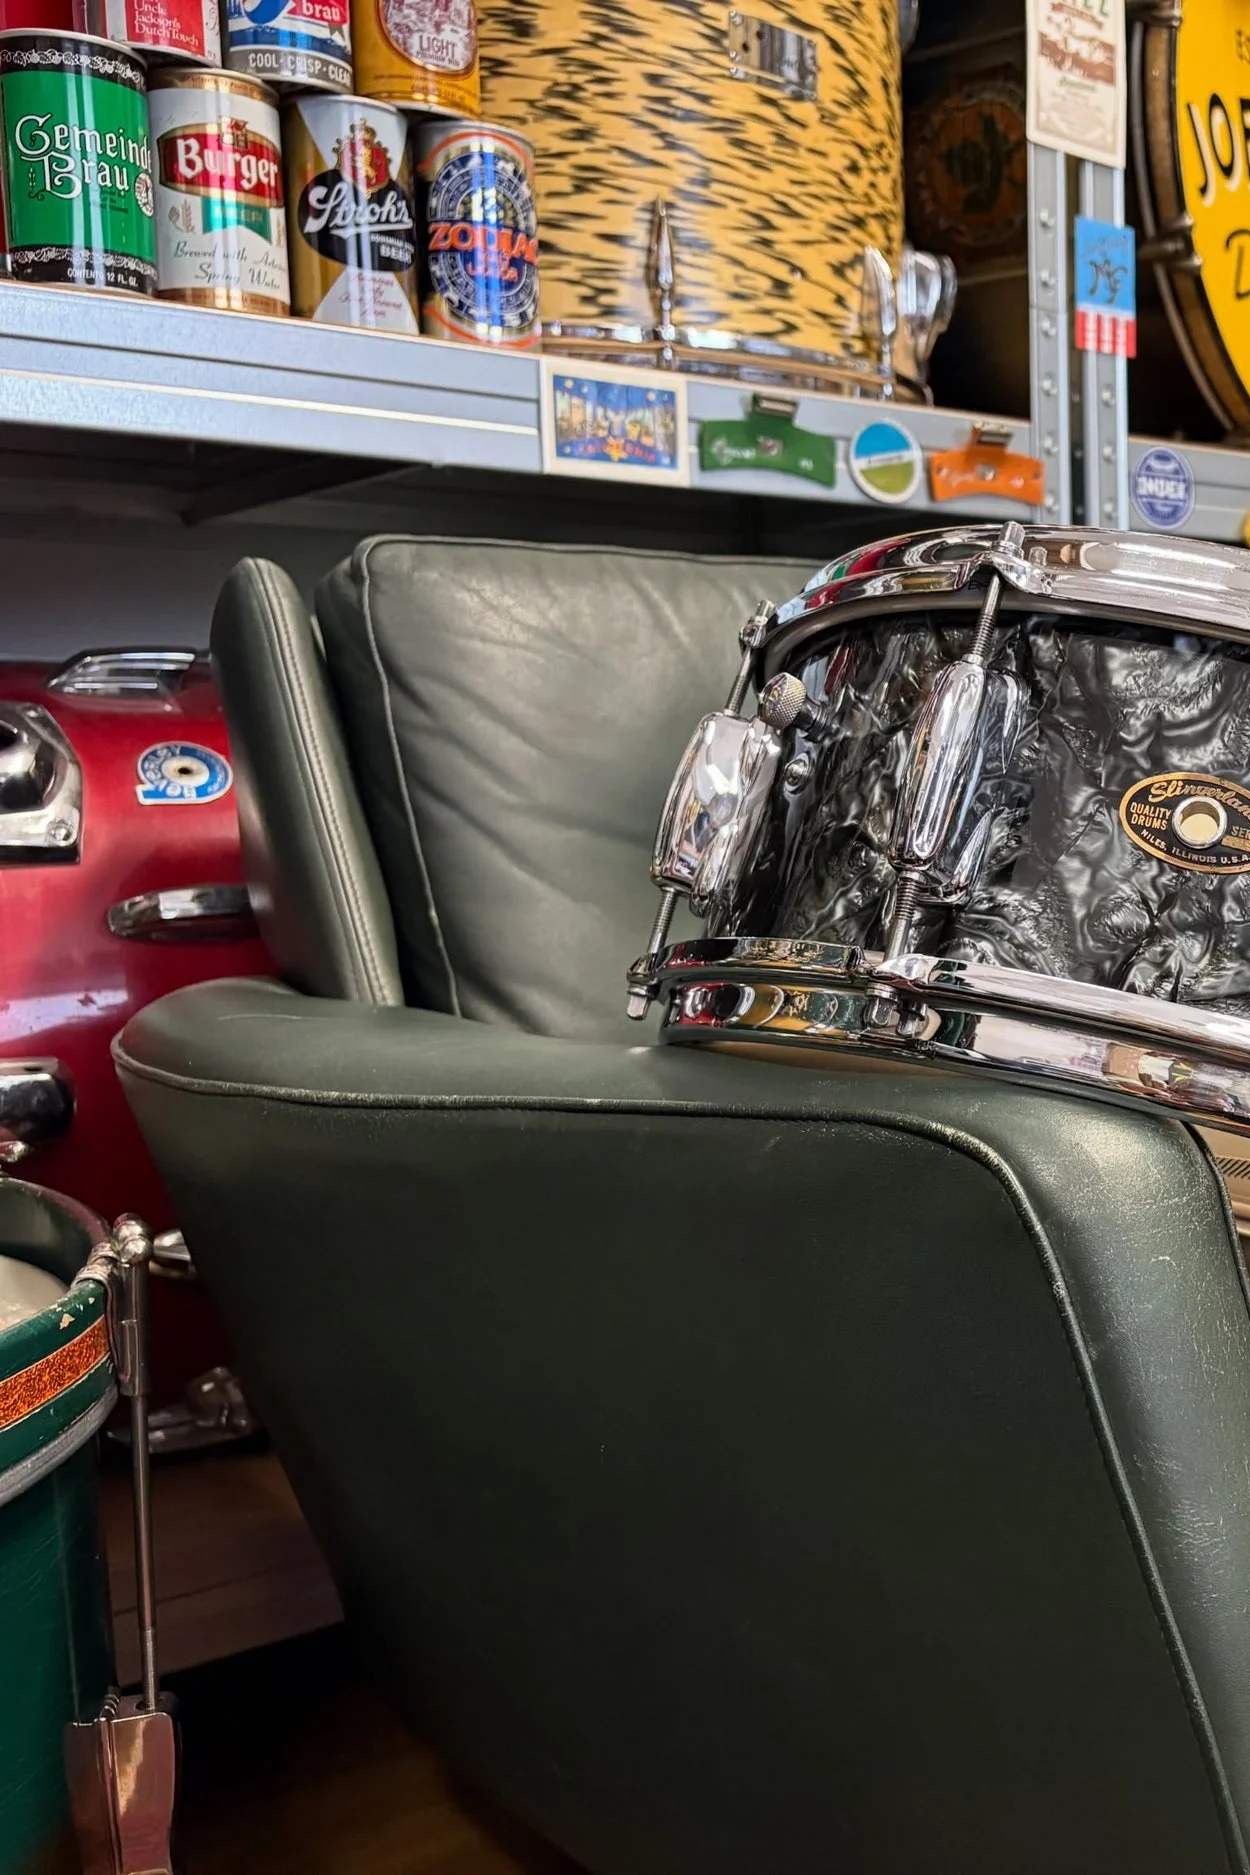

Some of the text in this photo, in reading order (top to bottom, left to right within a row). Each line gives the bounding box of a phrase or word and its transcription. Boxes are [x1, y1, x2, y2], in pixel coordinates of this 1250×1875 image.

[135, 20, 170, 38] Dutch
[419, 34, 457, 59] LIGHT
[248, 53, 279, 68] COOL
[287, 54, 321, 75] CRISP
[42, 151, 130, 199] Brau
[176, 138, 278, 190] Burger
[174, 241, 218, 259] Brewed
[1130, 802, 1172, 819] QUALITY
[1131, 813, 1168, 831] DRUMS
[1141, 829, 1250, 865] NILES, ILLINOIS U.S.A.
